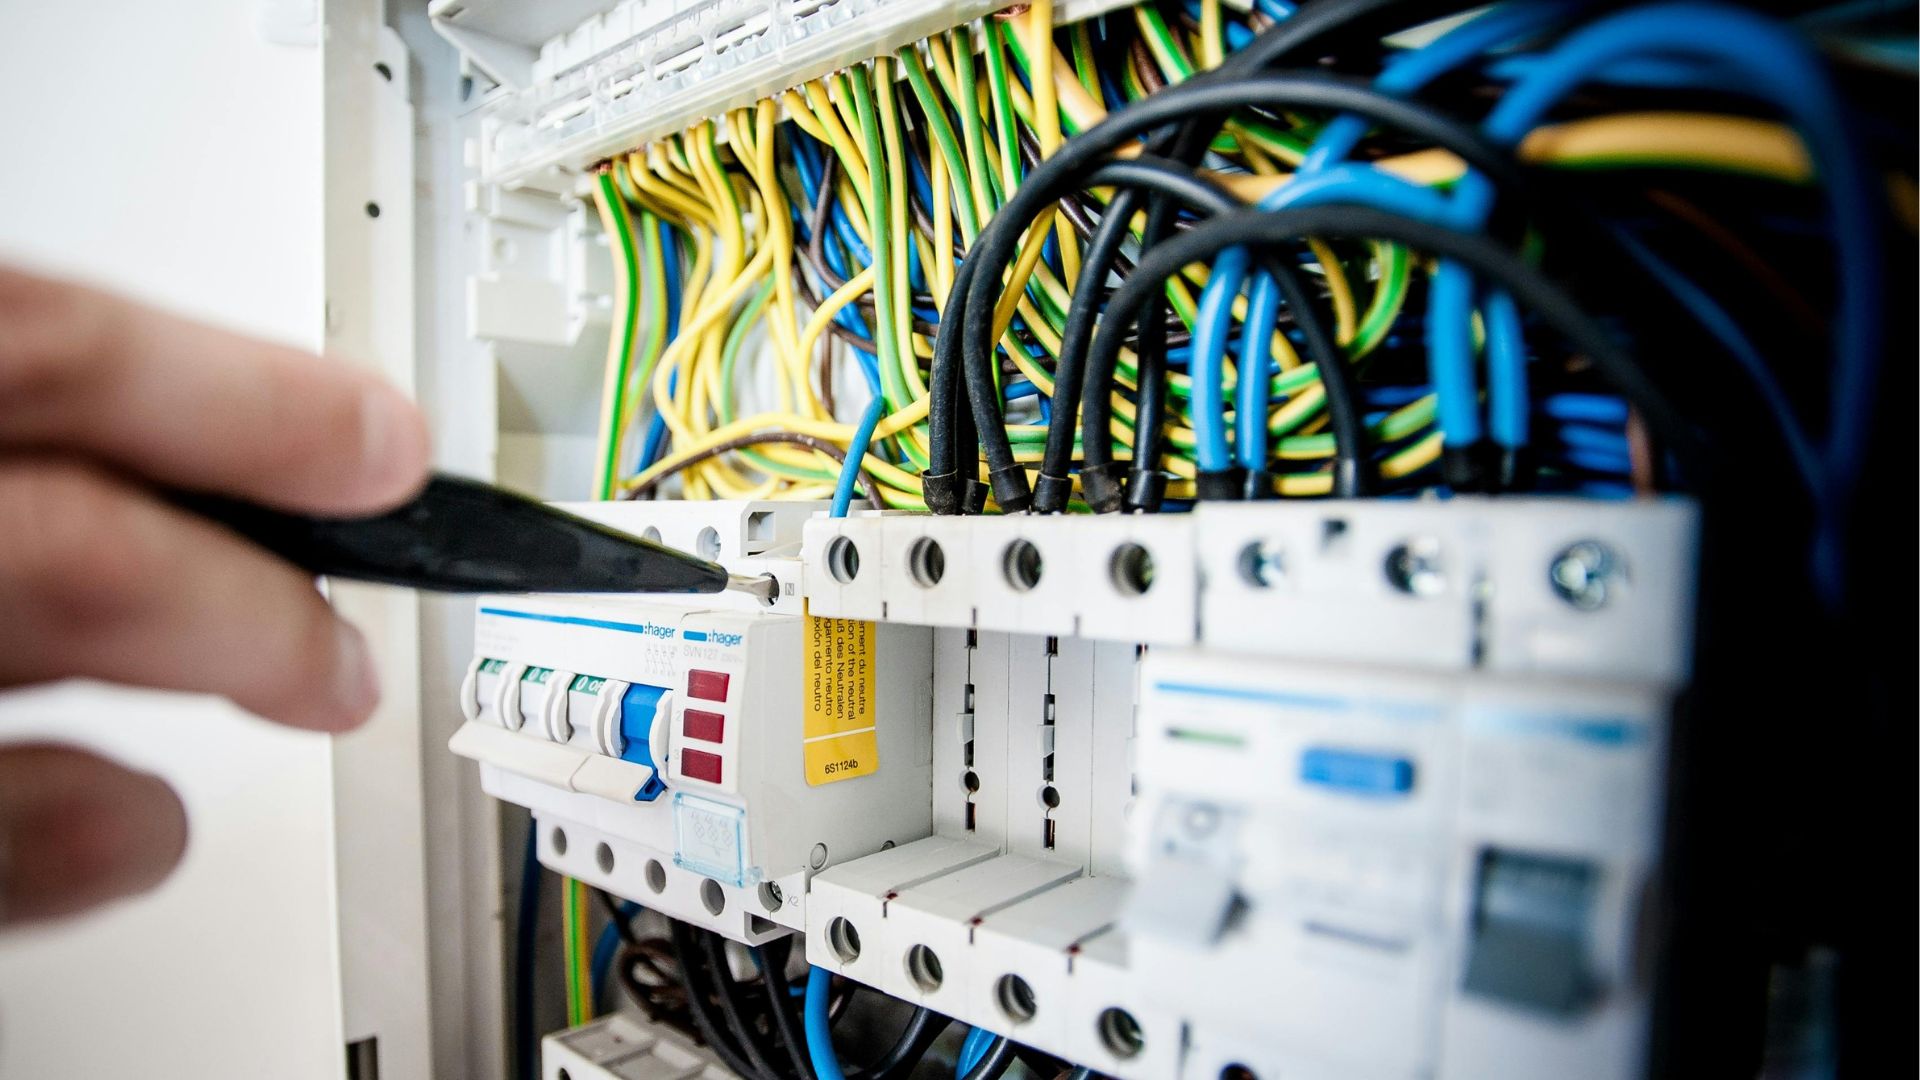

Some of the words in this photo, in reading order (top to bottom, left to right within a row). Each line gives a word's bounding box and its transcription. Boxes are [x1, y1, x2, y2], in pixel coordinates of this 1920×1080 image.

[836, 637, 845, 659] des
[847, 643, 856, 655] of
[814, 651, 822, 669] del
[847, 658, 856, 677] the
[858, 659, 867, 674] du
[814, 672, 822, 711] neutro
[825, 677, 833, 716] neutro
[836, 662, 845, 719] Neutralen
[847, 681, 856, 720] neutral
[858, 678, 866, 715] neutre
[825, 759, 858, 774] 6S1124b
